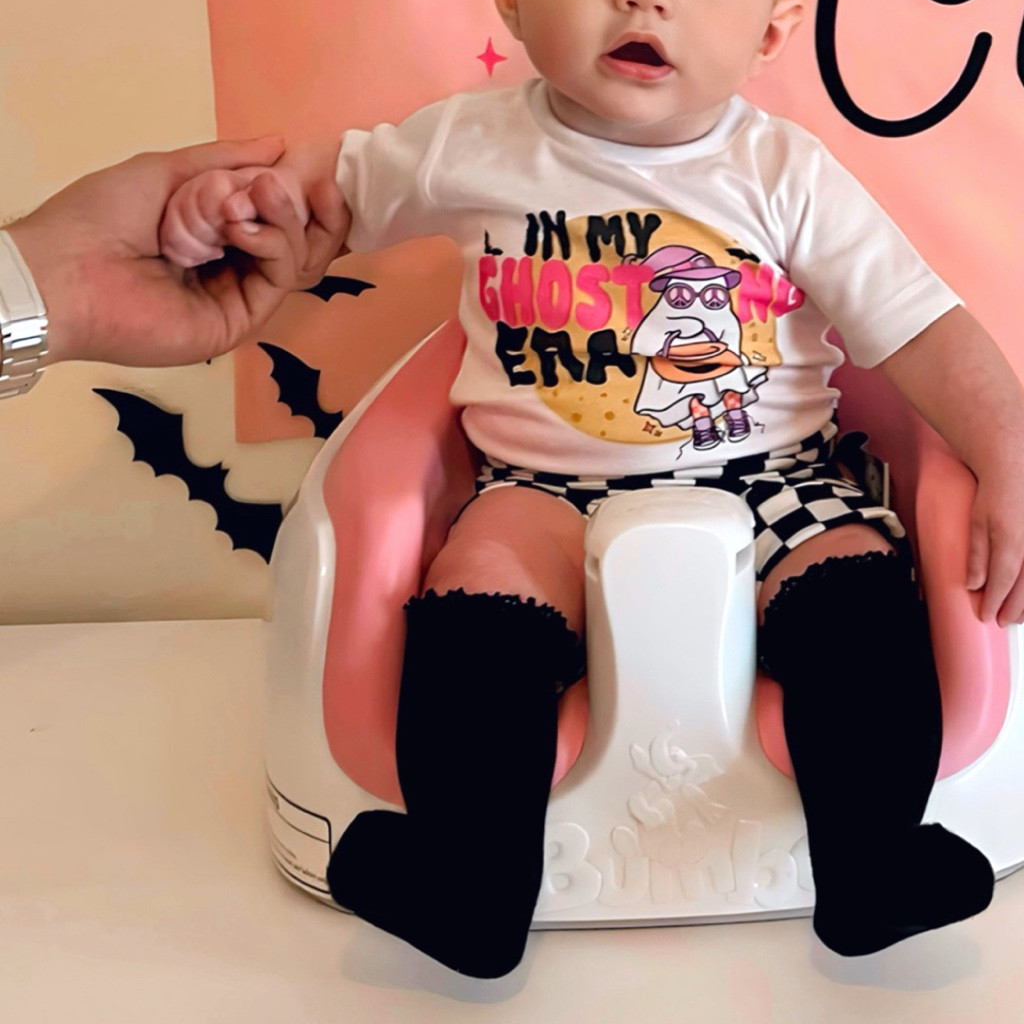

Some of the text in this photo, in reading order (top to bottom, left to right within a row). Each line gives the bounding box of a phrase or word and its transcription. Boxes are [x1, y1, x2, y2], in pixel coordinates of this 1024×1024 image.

[524, 210, 662, 262] IN MY
[496, 321, 637, 387] ERA
[540, 822, 815, 912] Bumb
